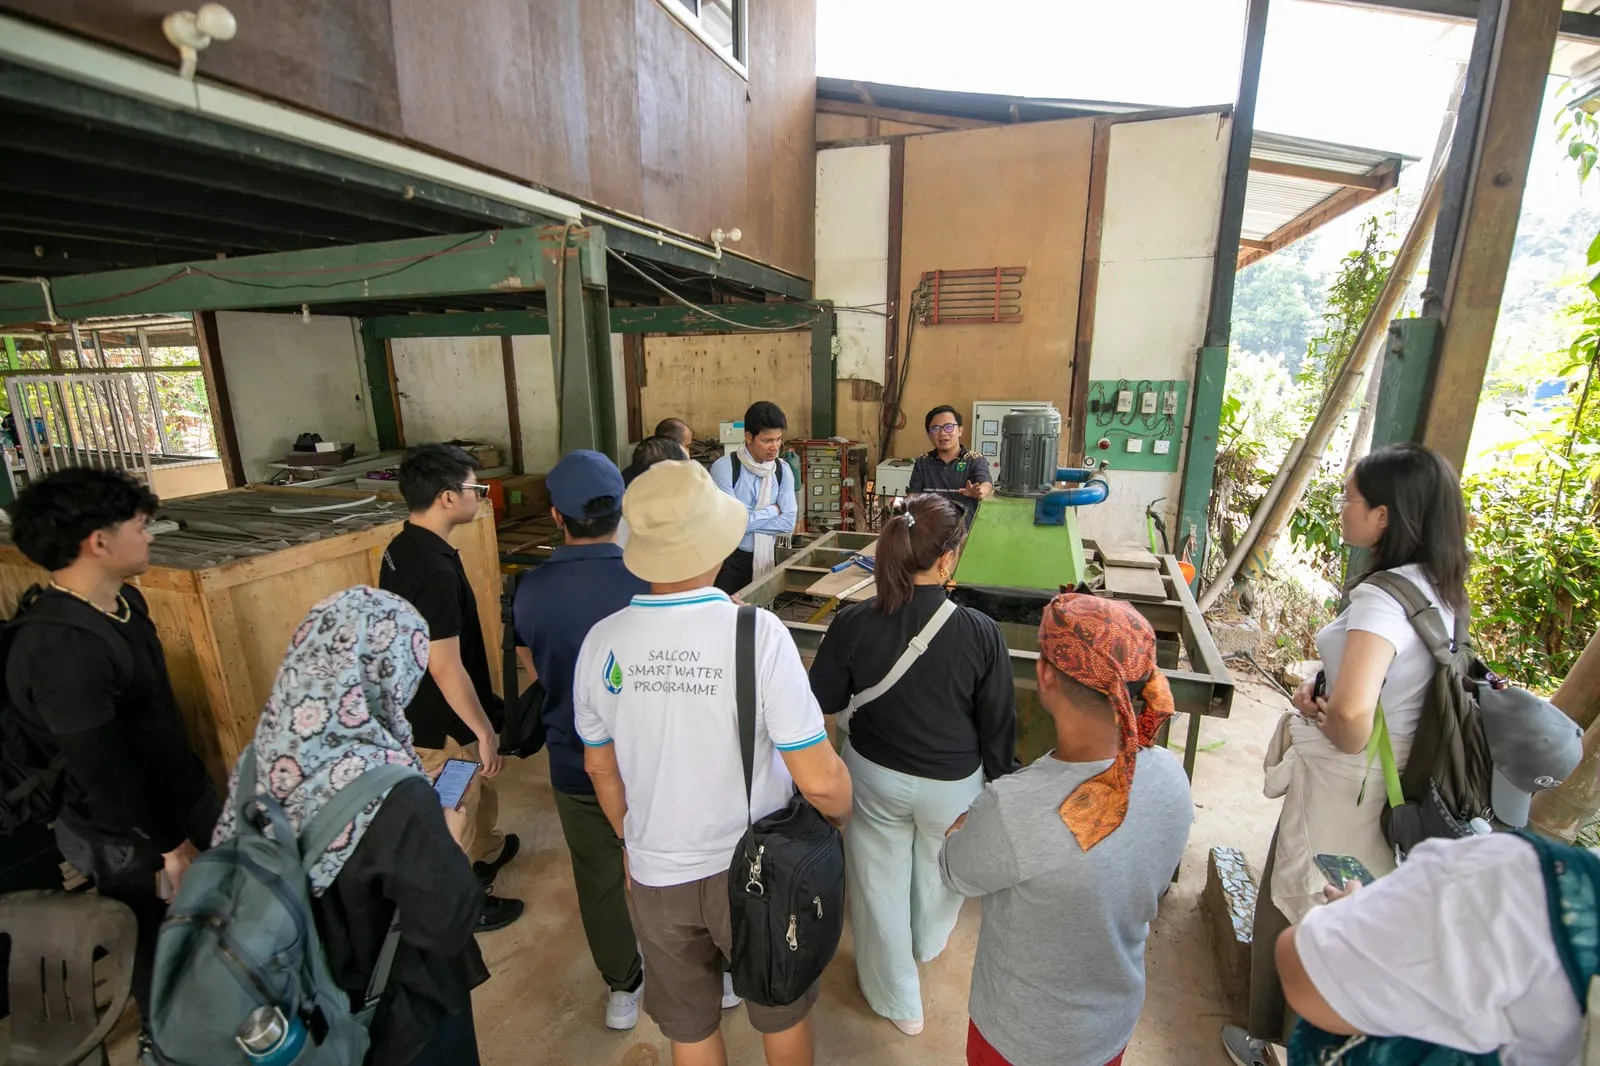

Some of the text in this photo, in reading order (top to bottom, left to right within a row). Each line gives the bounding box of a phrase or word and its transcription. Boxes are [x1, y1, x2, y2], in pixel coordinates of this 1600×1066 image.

[648, 650, 700, 662] SALCON
[627, 664, 723, 679] SMART WATER
[634, 681, 718, 696] PROGRAMME
